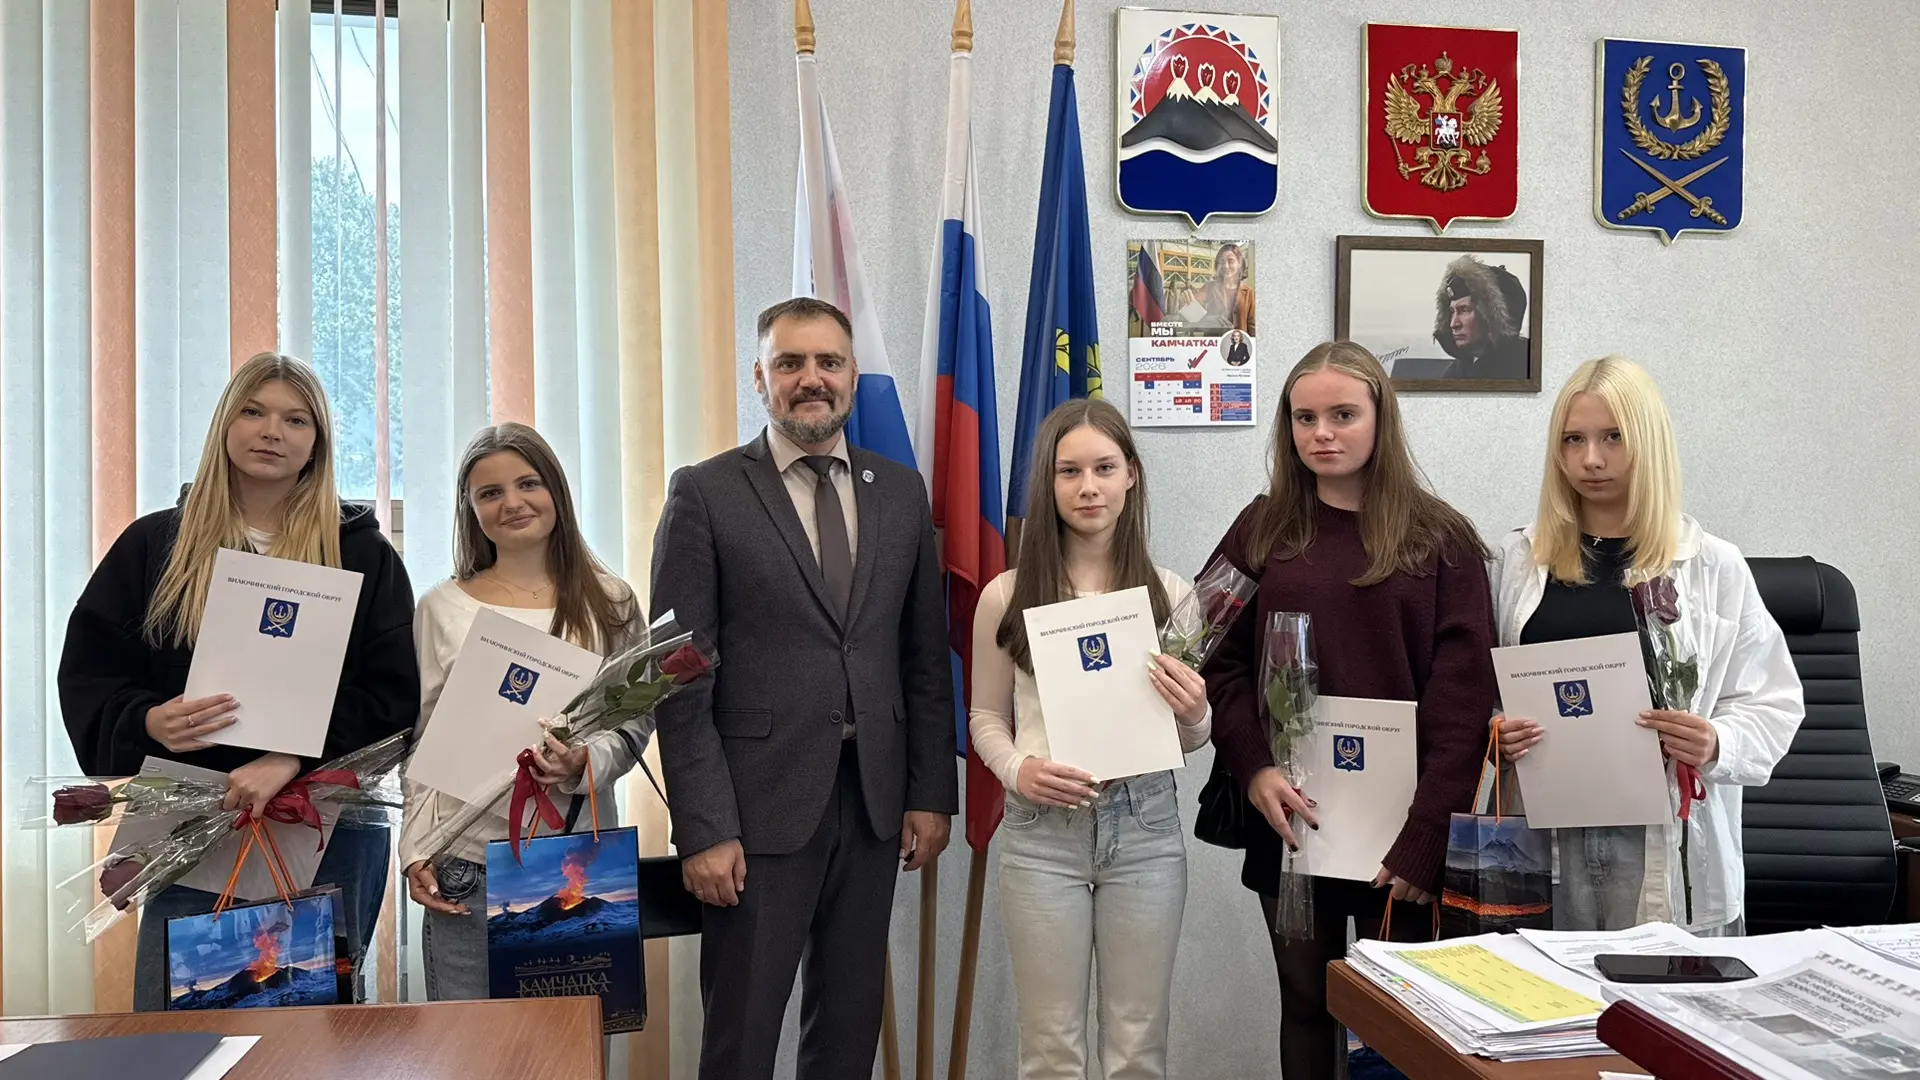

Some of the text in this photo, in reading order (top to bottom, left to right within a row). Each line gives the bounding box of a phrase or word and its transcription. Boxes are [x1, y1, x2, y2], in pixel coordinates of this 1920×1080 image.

[1151, 328, 1173, 336] МЫ
[1151, 339, 1218, 347] КАМЧАТКА!
[281, 586, 321, 598] ГОРОДСКОЙ
[321, 594, 342, 602] ОКРУГ
[1086, 616, 1120, 628] ГОРОДСКОЙ
[1120, 613, 1139, 621] ОКРУГ
[526, 654, 561, 673] ГОРОДСКОЙ
[561, 669, 580, 680] ОКРУГ
[1563, 663, 1604, 673] ГОРОДСКОЙ
[1345, 723, 1381, 731] ГОРОДСКОЙ
[519, 971, 610, 991] КАМЧАТКА
